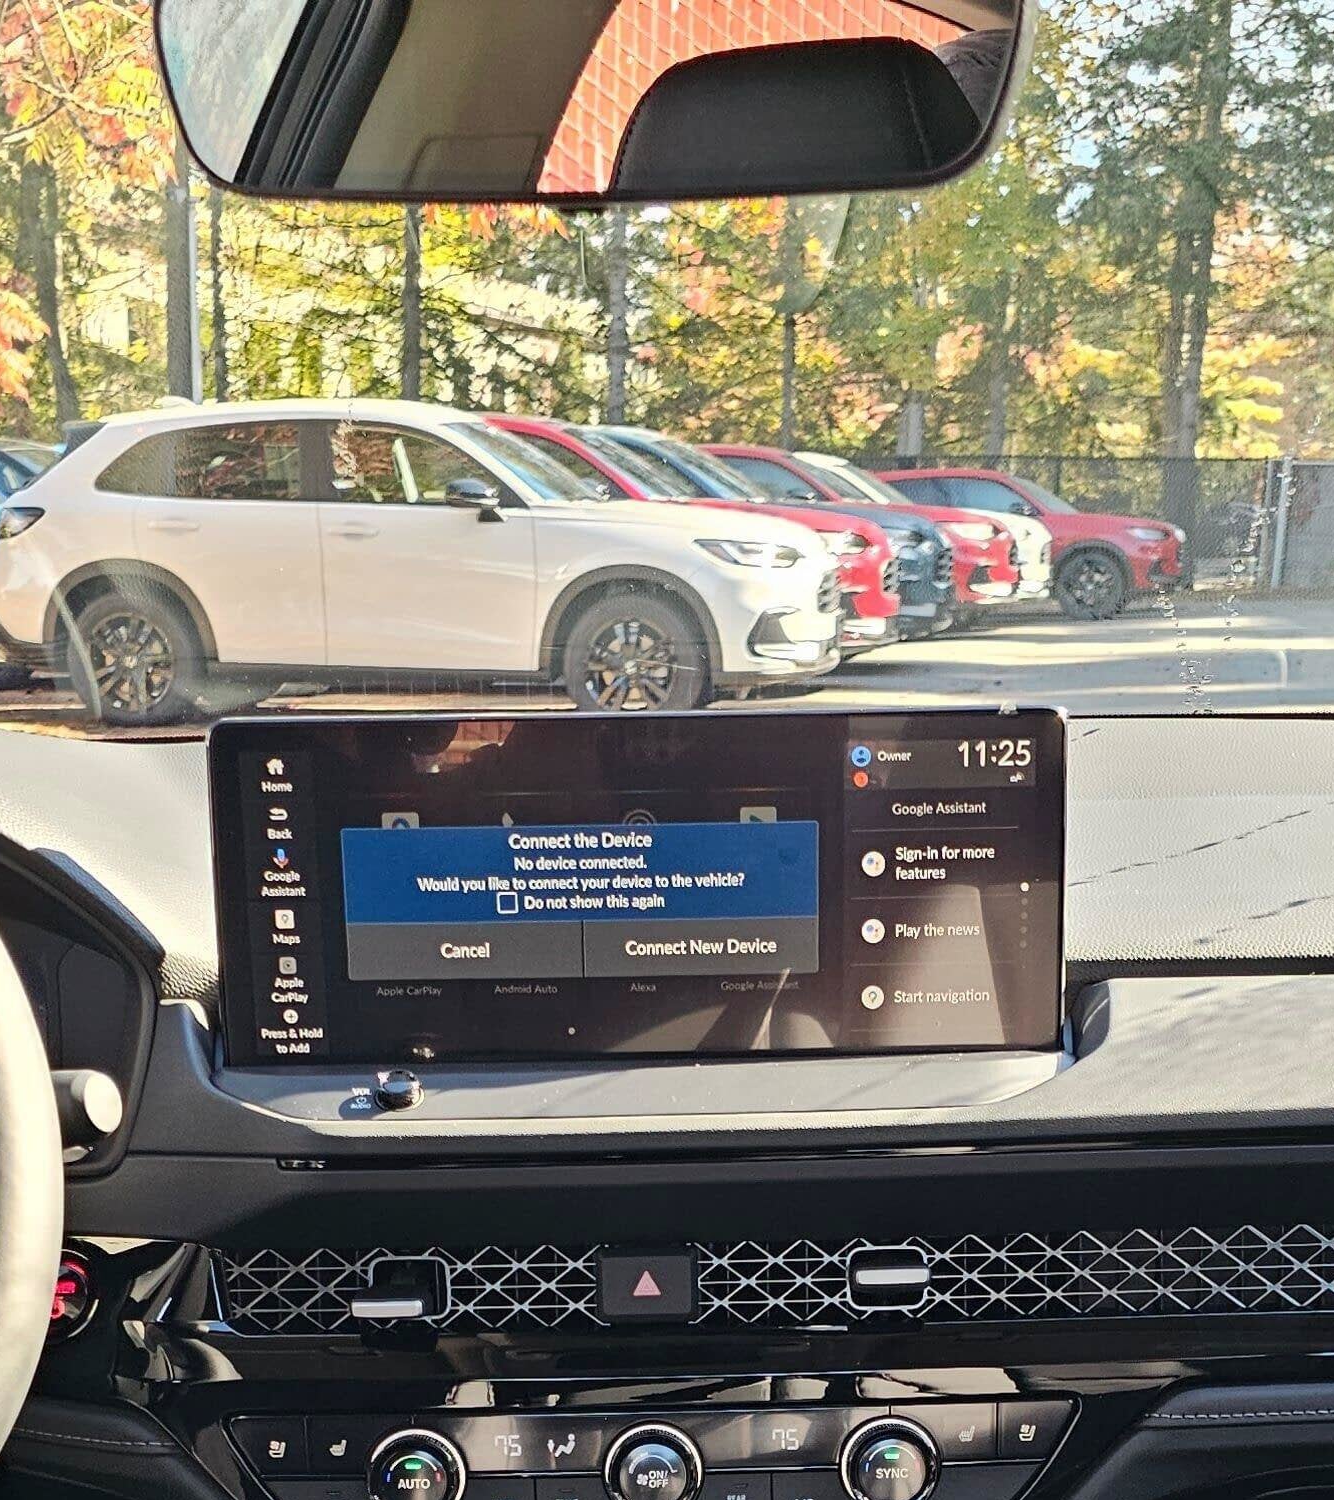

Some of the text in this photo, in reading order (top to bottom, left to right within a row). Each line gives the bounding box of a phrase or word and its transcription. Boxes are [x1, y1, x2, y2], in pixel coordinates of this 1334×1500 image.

[877, 751, 912, 762] Owner
[957, 739, 1032, 768] 11:25
[261, 781, 293, 792] Home
[892, 802, 986, 817] Google Assistant
[267, 829, 293, 840] Back
[508, 832, 653, 850] Connect the Device
[895, 846, 995, 863] Sign-in for more
[514, 855, 647, 870] No device connected.
[264, 871, 300, 883] Google
[895, 867, 946, 881] features
[417, 872, 746, 893] Would you like to connect your device to the vehicle?
[261, 886, 306, 897] Assistant
[524, 893, 665, 911] Do not show this again
[895, 923, 980, 940] Play the news
[272, 934, 300, 945] Maps
[440, 942, 491, 959] Cancel
[625, 938, 777, 956] Connect New Device
[274, 977, 304, 989] Apple
[630, 982, 657, 992] Alexa
[720, 980, 754, 991] Google
[376, 986, 443, 997] Apple CarPlay
[494, 985, 558, 994] Android Auto
[271, 992, 308, 1005] CarPlay
[893, 989, 990, 1004] Start navigation
[261, 1028, 323, 1040] Press & Hold
[276, 1043, 310, 1054] to Add
[351, 1087, 372, 1096] VOL
[495, 1434, 522, 1457] 75
[772, 1428, 800, 1451] 75
[648, 1470, 668, 1480] ON/
[875, 1467, 909, 1480] SYNC
[397, 1478, 431, 1490] AUTO
[648, 1479, 668, 1489] OFF
